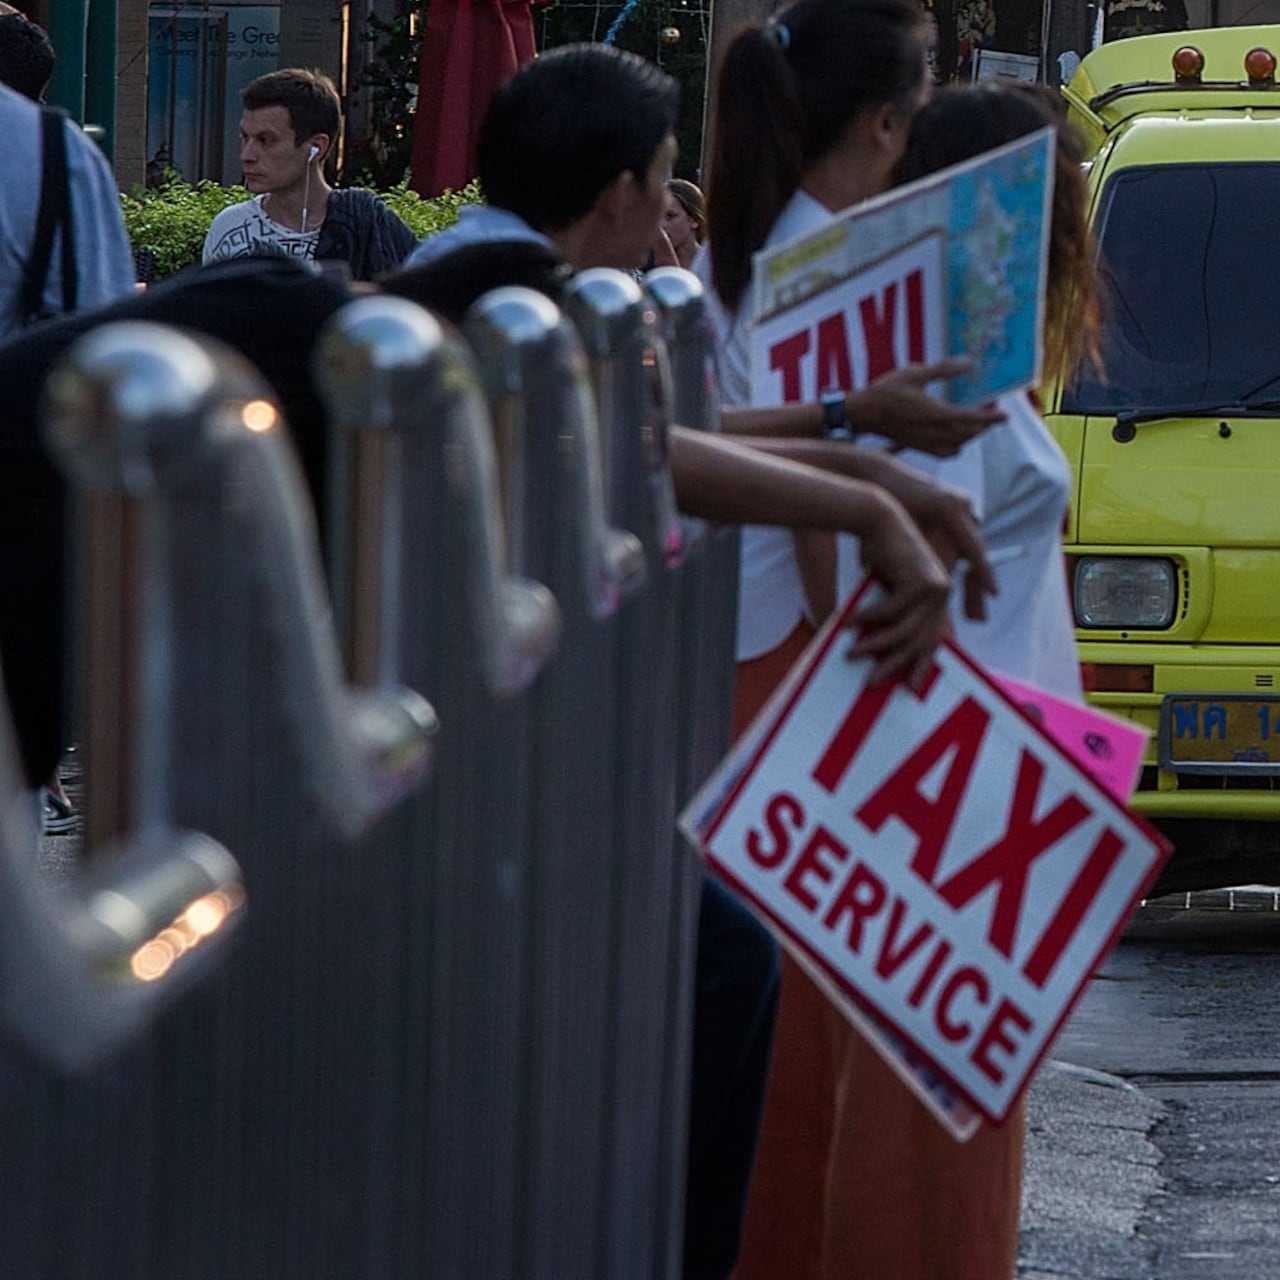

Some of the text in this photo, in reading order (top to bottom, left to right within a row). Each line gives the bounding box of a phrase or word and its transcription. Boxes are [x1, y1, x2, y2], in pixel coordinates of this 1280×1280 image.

[770, 268, 925, 404] TAXI
[744, 790, 1035, 1085] SERVICE
[811, 664, 1128, 990] TAXI
